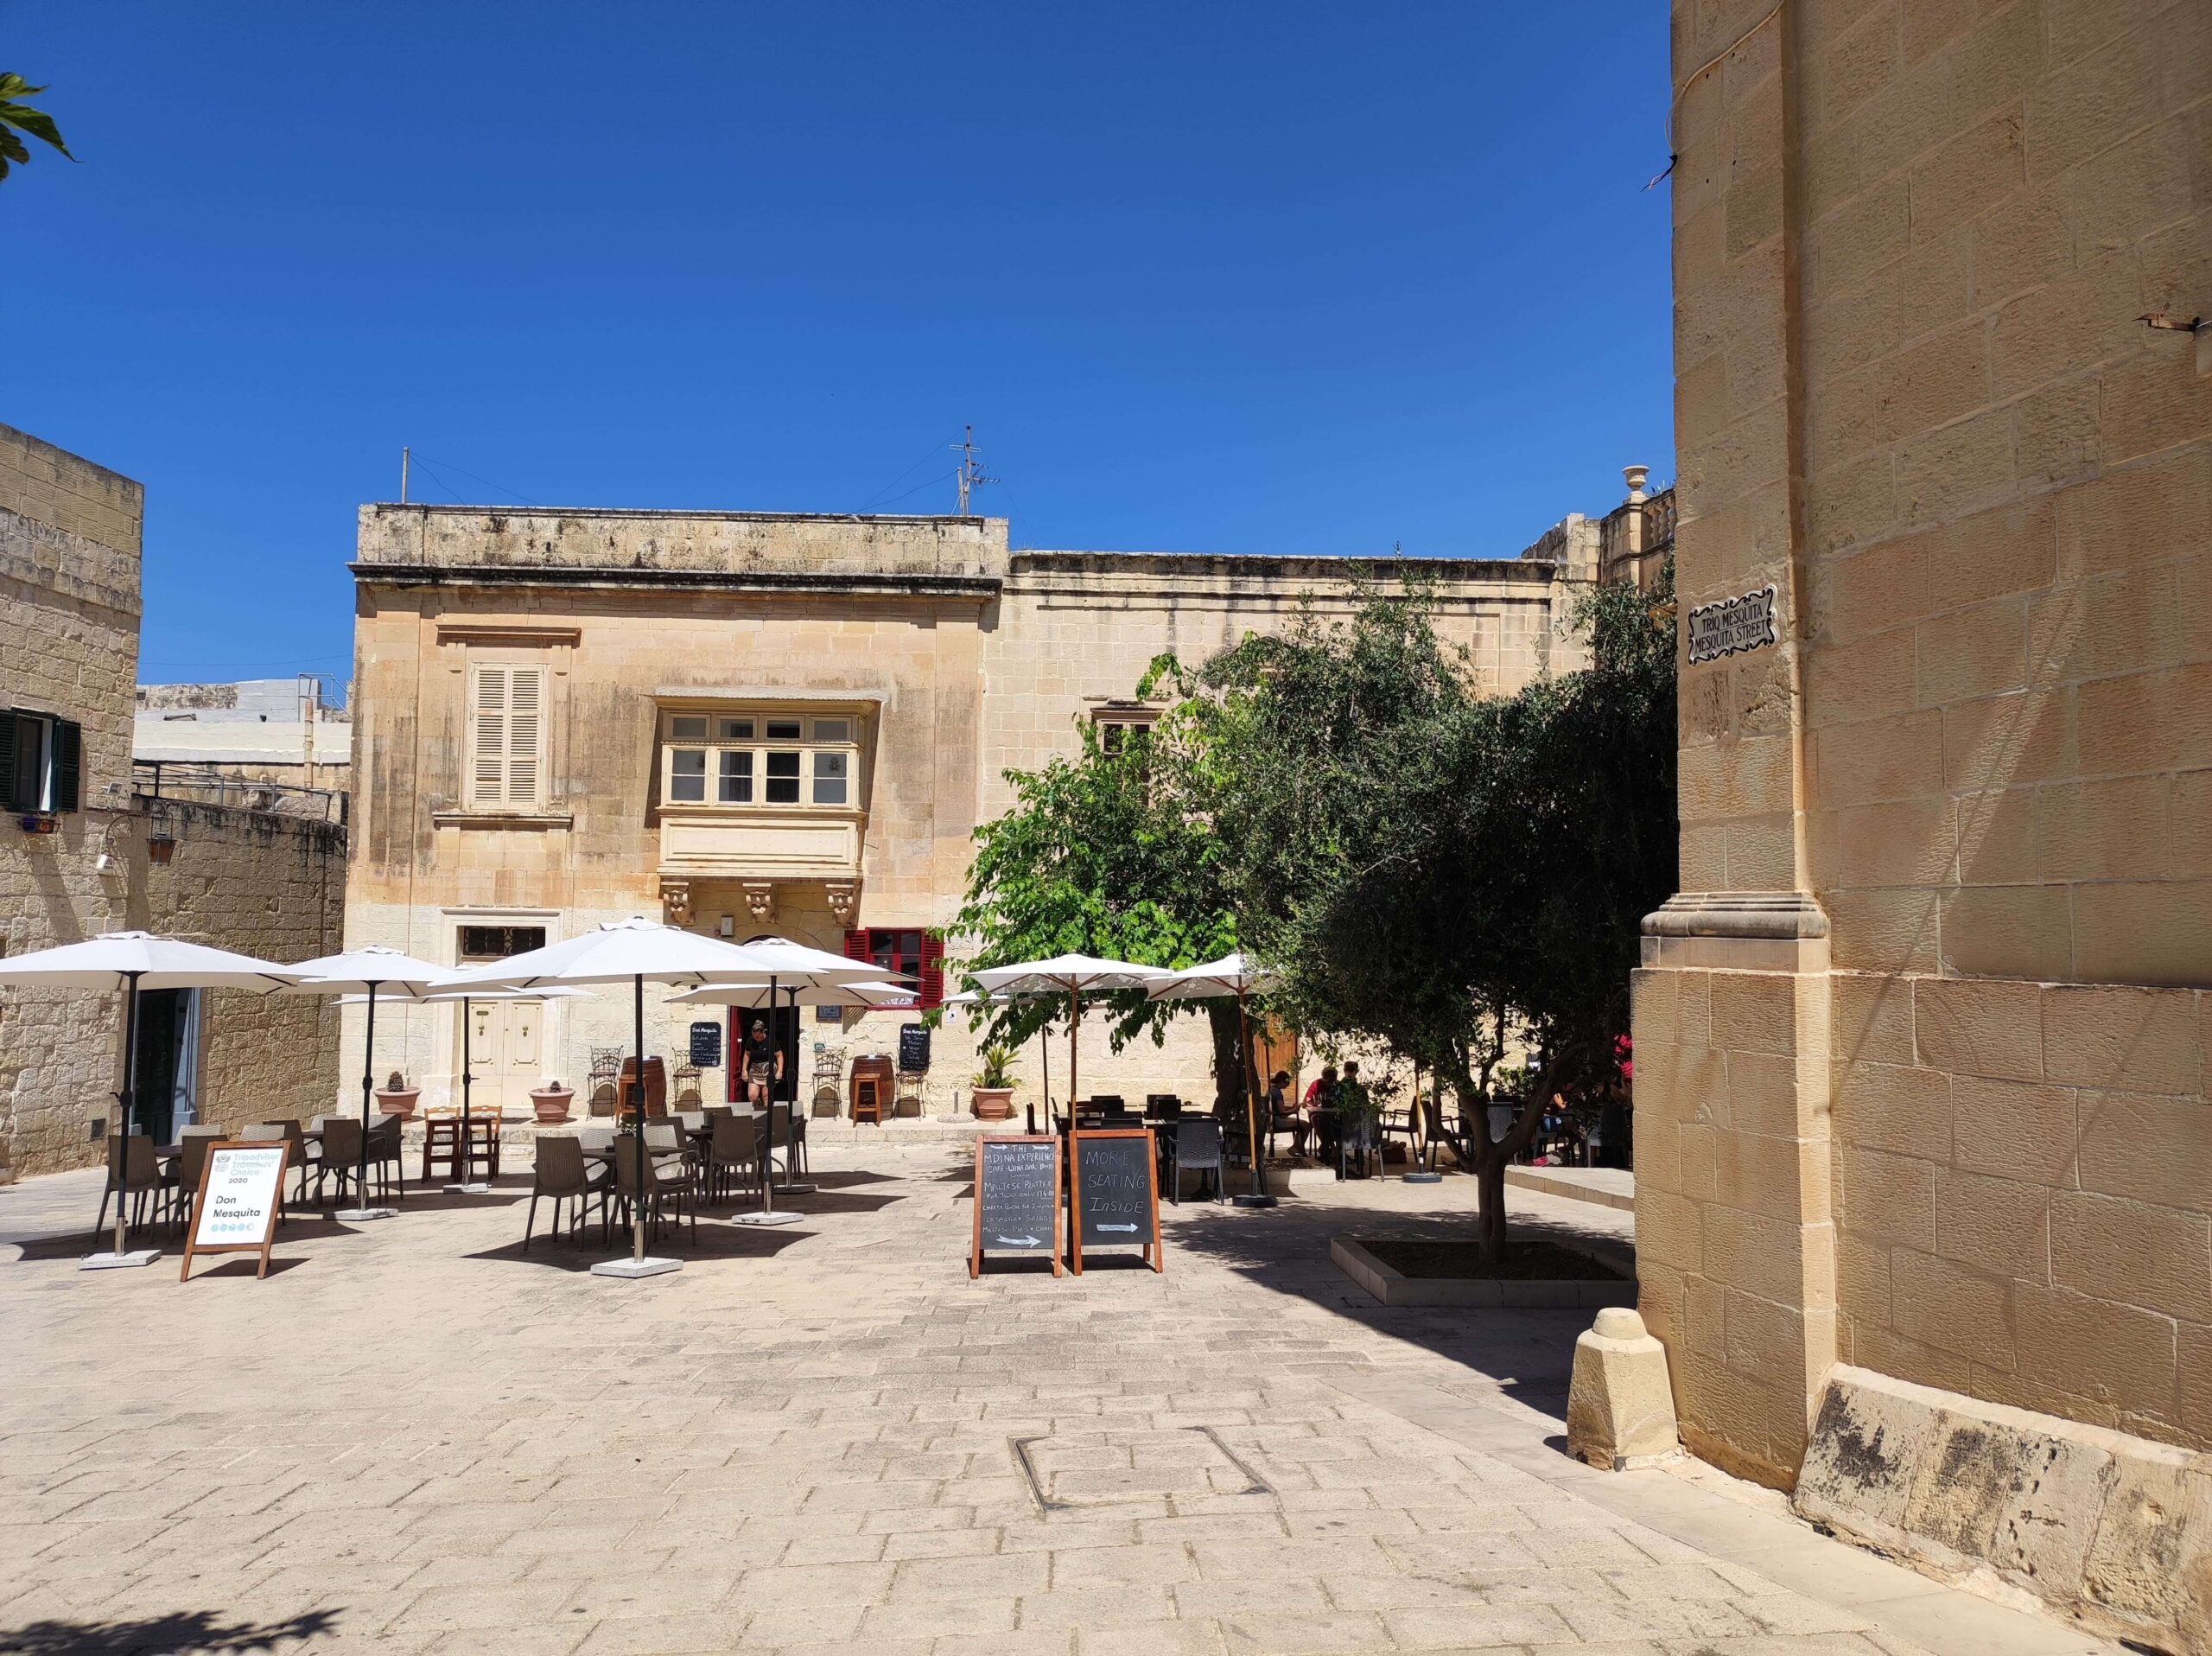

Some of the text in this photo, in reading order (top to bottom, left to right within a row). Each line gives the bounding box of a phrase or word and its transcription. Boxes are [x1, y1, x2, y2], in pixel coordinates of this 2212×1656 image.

[1702, 603, 1763, 633] TRIQ MESQUITA
[1694, 619, 1766, 653] MESQUITA STREET
[234, 1153, 279, 1162] Tripadvisor
[984, 1152, 1054, 1163] MDINA EXPERIENCE
[1085, 1150, 1130, 1166] MORE
[231, 1168, 260, 1176] Choice
[1088, 1174, 1146, 1188] SEATING
[215, 1195, 237, 1205] Don
[213, 1207, 261, 1220] Mesquita
